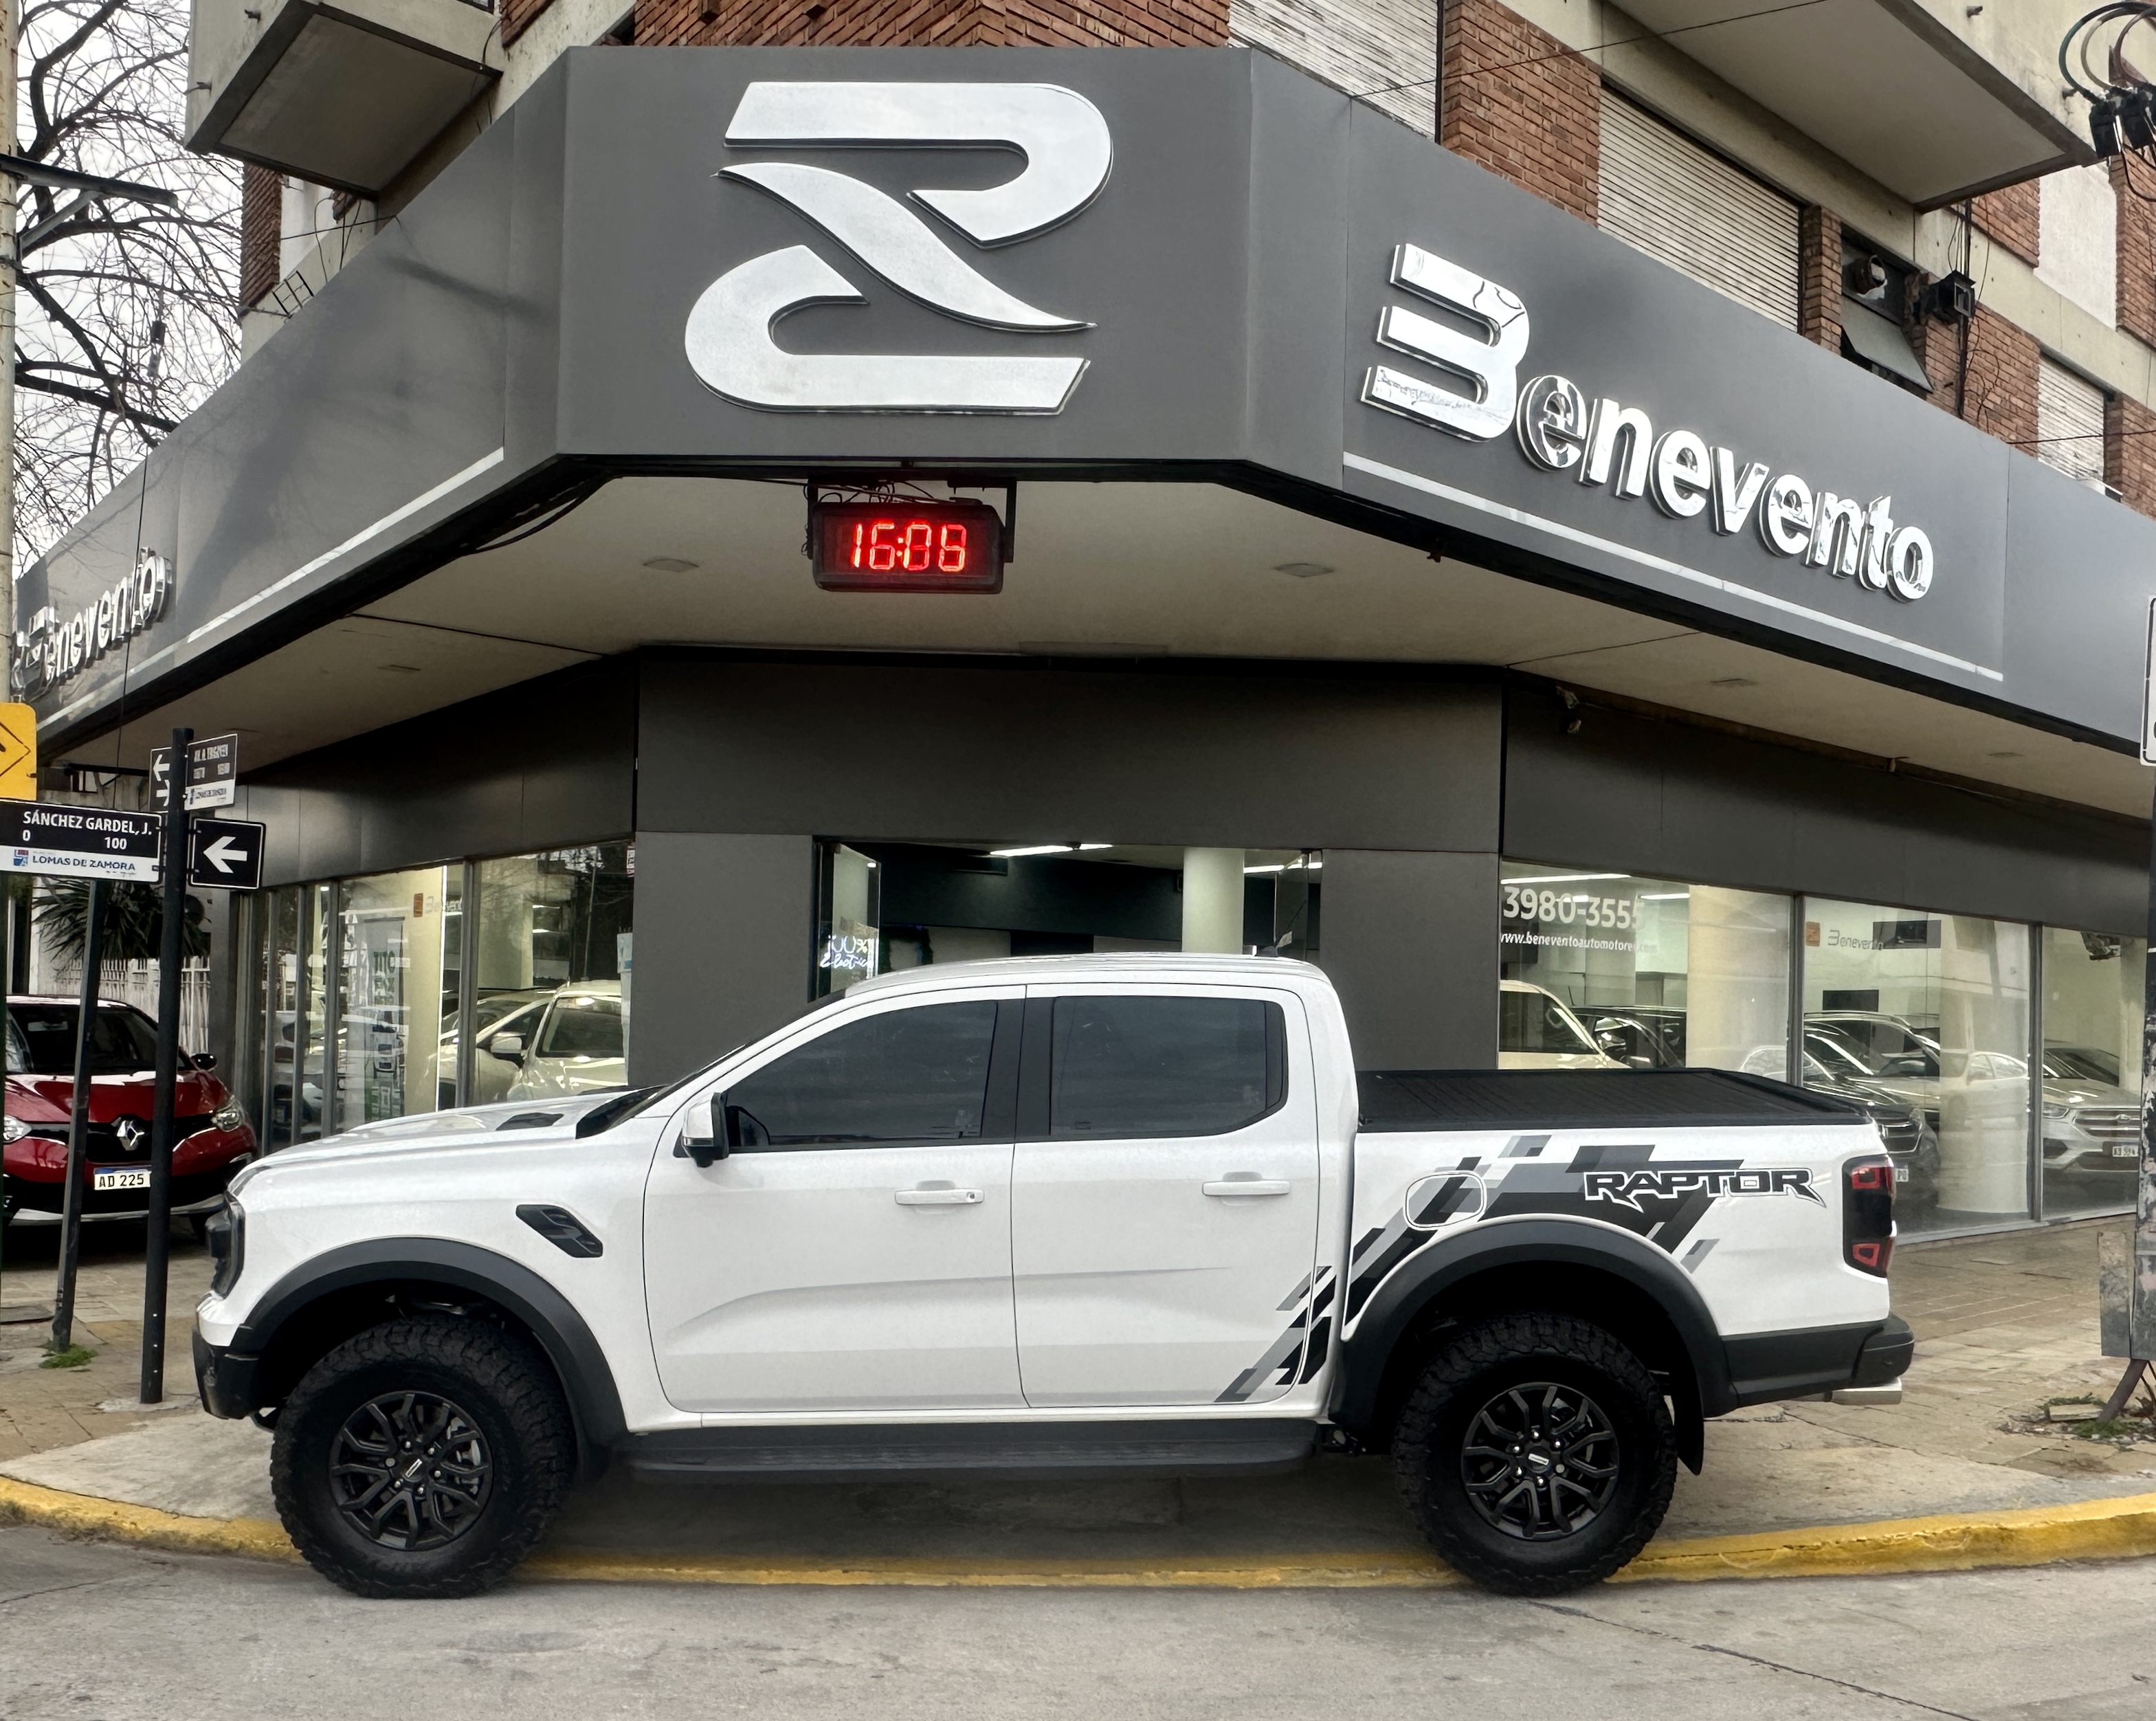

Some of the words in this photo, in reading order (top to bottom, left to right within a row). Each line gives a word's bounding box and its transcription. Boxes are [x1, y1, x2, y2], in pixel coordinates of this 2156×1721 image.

[1359, 243, 1935, 603] Benevento
[23, 810, 83, 829] SÁNCHEZ
[86, 817, 140, 836] GARDEL,
[142, 822, 152, 836] J.
[22, 830, 31, 842] 0
[104, 836, 127, 850] 100
[32, 855, 70, 866] LOMAS
[73, 858, 87, 867] DE
[89, 859, 135, 871] ZAMORA
[99, 1175, 115, 1188] AD
[120, 1173, 144, 1186] 225
[1584, 1168, 1826, 1213] RAPTOR
